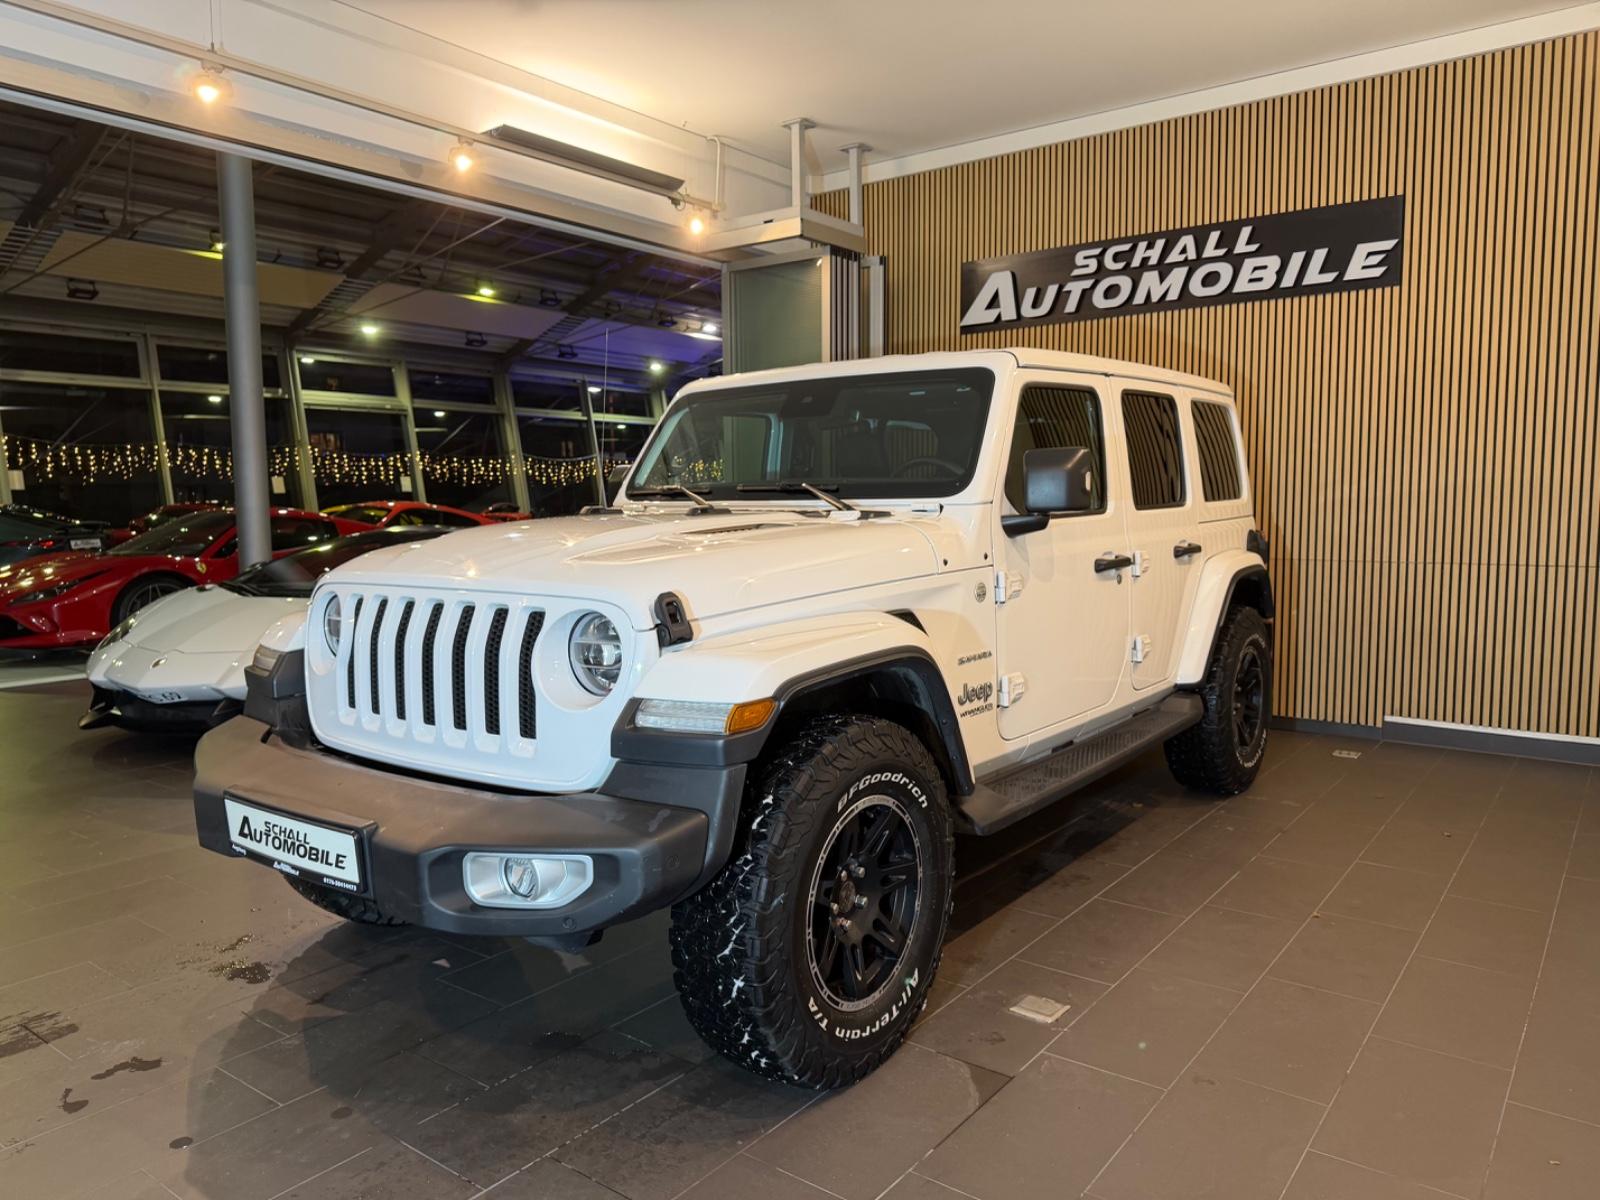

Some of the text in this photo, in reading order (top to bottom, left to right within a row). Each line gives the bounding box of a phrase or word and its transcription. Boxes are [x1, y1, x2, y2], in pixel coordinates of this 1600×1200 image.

[1070, 225, 1262, 277] SCHALL
[959, 238, 1400, 327] AUTOMOBILE
[958, 681, 993, 707] Jeep
[837, 771, 928, 813] BFGoodrich
[239, 816, 347, 869] AUTOMOBILE
[263, 820, 310, 845] SCHALL
[807, 967, 919, 1042] All-Terrain T/A
